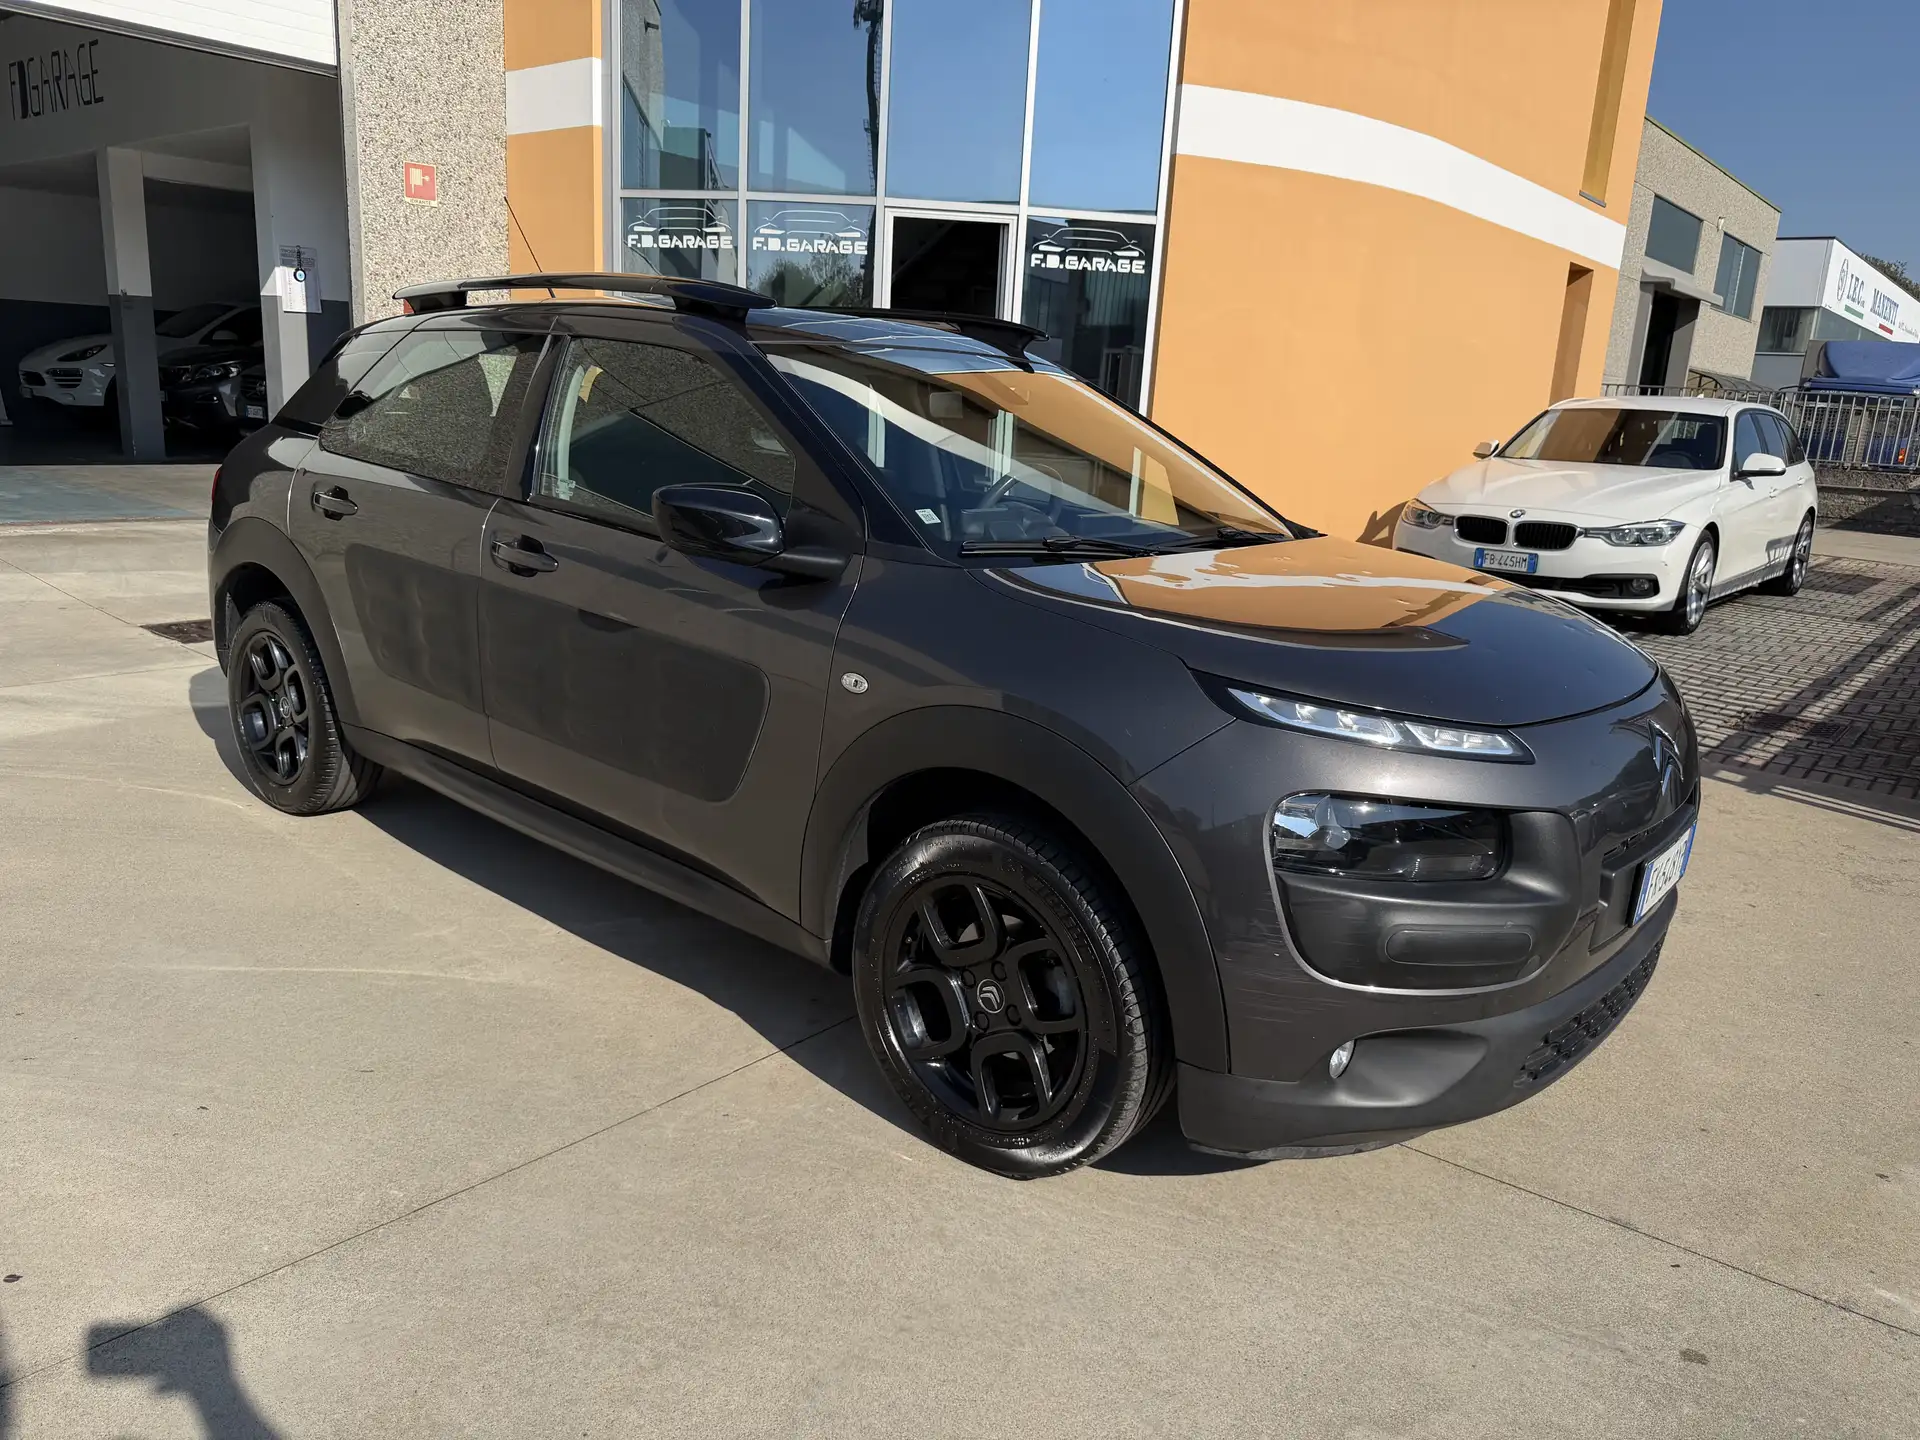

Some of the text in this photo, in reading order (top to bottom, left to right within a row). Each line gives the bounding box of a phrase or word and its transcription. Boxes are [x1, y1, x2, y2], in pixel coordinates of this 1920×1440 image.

[627, 235, 733, 249] F.D.GARAGE
[752, 237, 868, 255] F.D.GARAGE
[1030, 253, 1146, 274] F.D.GARAGE
